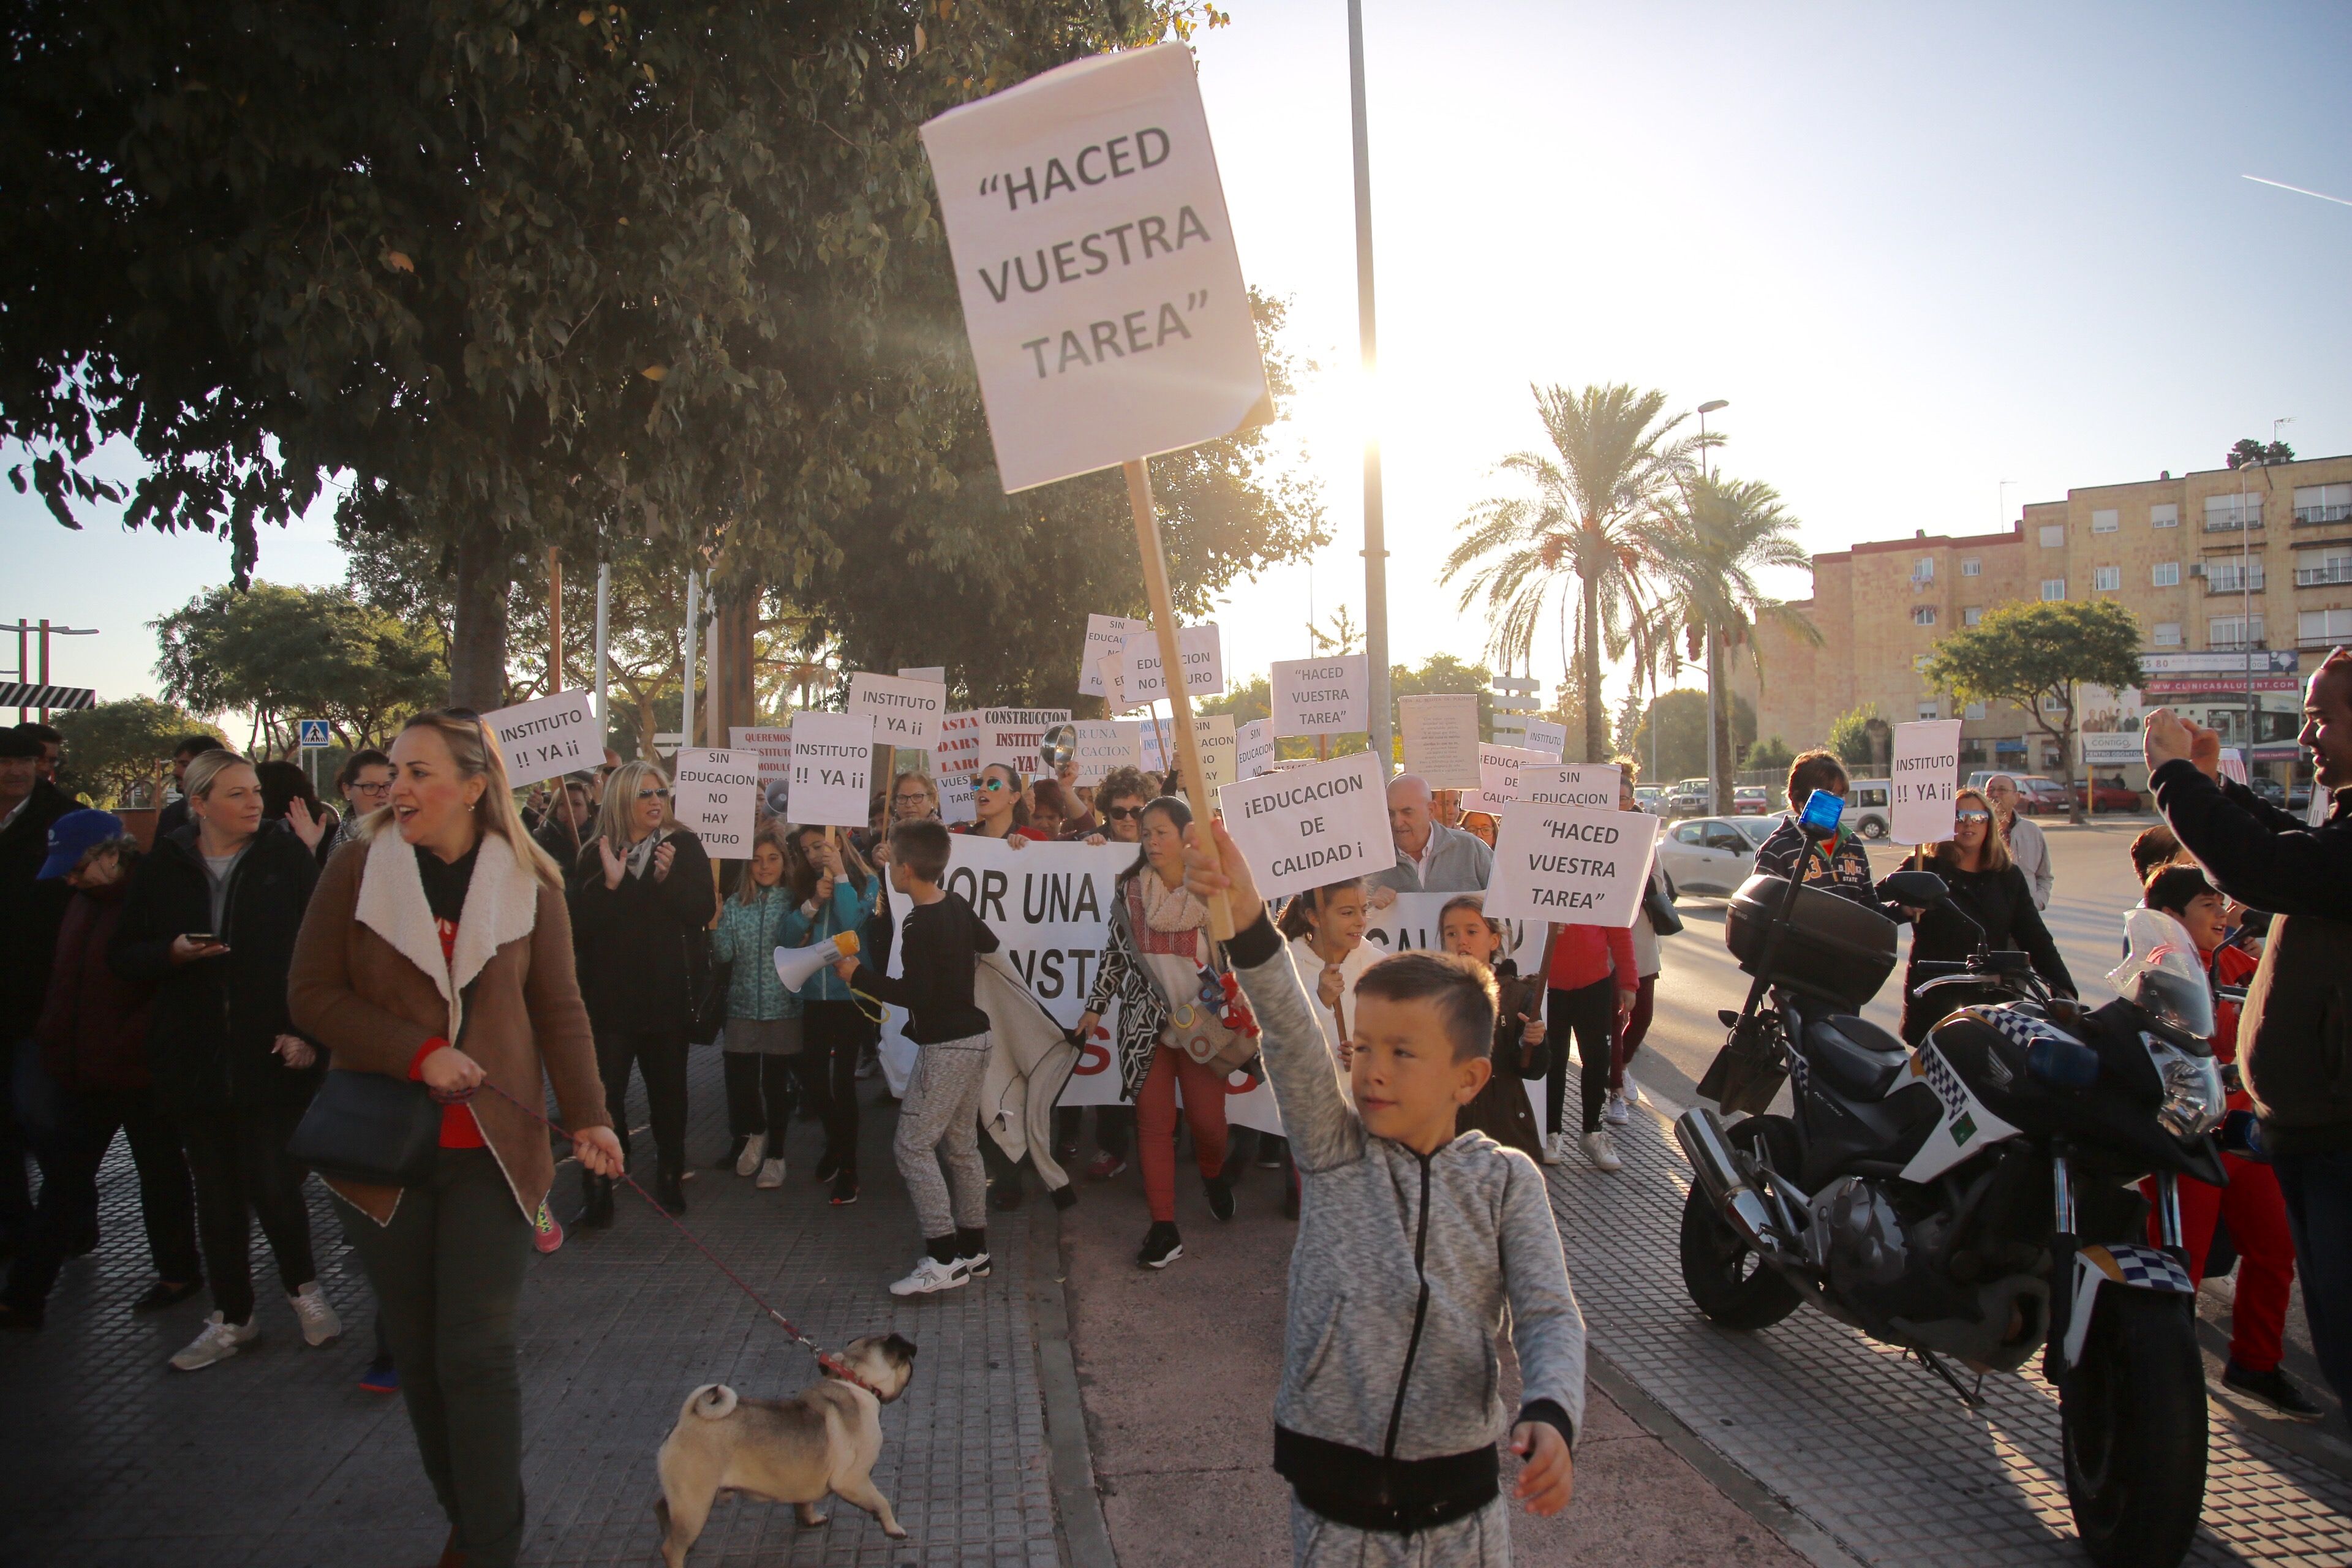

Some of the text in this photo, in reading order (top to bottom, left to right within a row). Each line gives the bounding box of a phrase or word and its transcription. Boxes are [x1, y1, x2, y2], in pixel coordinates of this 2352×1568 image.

[979, 127, 1170, 211] “HACED
[978, 205, 1212, 303] VUESTRA
[1022, 289, 1208, 379] TAREA”
[1109, 620, 1125, 630] SIN
[1137, 652, 1210, 669] EDUCION
[2156, 659, 2168, 668] 80
[1139, 678, 1157, 690] NO
[1161, 672, 1212, 687] FURO
[1295, 667, 1343, 681] “HACED
[863, 691, 936, 710] INSTITUTO
[1292, 688, 1349, 703] VUESTRA
[887, 717, 907, 732] YA
[943, 717, 979, 731] ASTA
[985, 711, 1067, 725] CONSTRUCCION
[1299, 710, 1346, 725] TAREA”
[500, 710, 582, 743] INSTITUTO
[1091, 729, 1118, 739] UNA
[1251, 728, 1261, 739] SIN
[745, 733, 791, 743] QUEREMOS
[938, 737, 979, 752] DARN
[1530, 732, 1561, 745] INSTITUTO
[537, 744, 563, 762] YA
[709, 753, 729, 764] SIN
[796, 744, 868, 758] INSTITUTO
[1239, 742, 1273, 763] EDUCACION
[1480, 755, 1528, 769] ¡EDUCA
[1896, 755, 1954, 771] INSTITUTO
[680, 771, 755, 786] EDUCACION
[820, 769, 845, 786] YA
[941, 775, 970, 788] VUES
[1205, 772, 1217, 780] AY
[1504, 777, 1518, 787] DE
[1559, 772, 1580, 783] SIN
[708, 793, 728, 804] NO
[949, 792, 974, 804] TARE
[1245, 774, 1363, 819] ¡EDUCACION
[1532, 793, 1608, 804] EDUCACION
[1917, 783, 1937, 801] YA
[702, 813, 728, 824] HAY
[1300, 816, 1325, 837] DE
[1543, 820, 1619, 844] “HACED
[696, 832, 739, 844] UTURO
[1272, 844, 1352, 877] CALIDAD
[1529, 854, 1616, 878] VUESTRA
[1023, 873, 1101, 924] UNA
[1532, 888, 1605, 909] TAREA”
